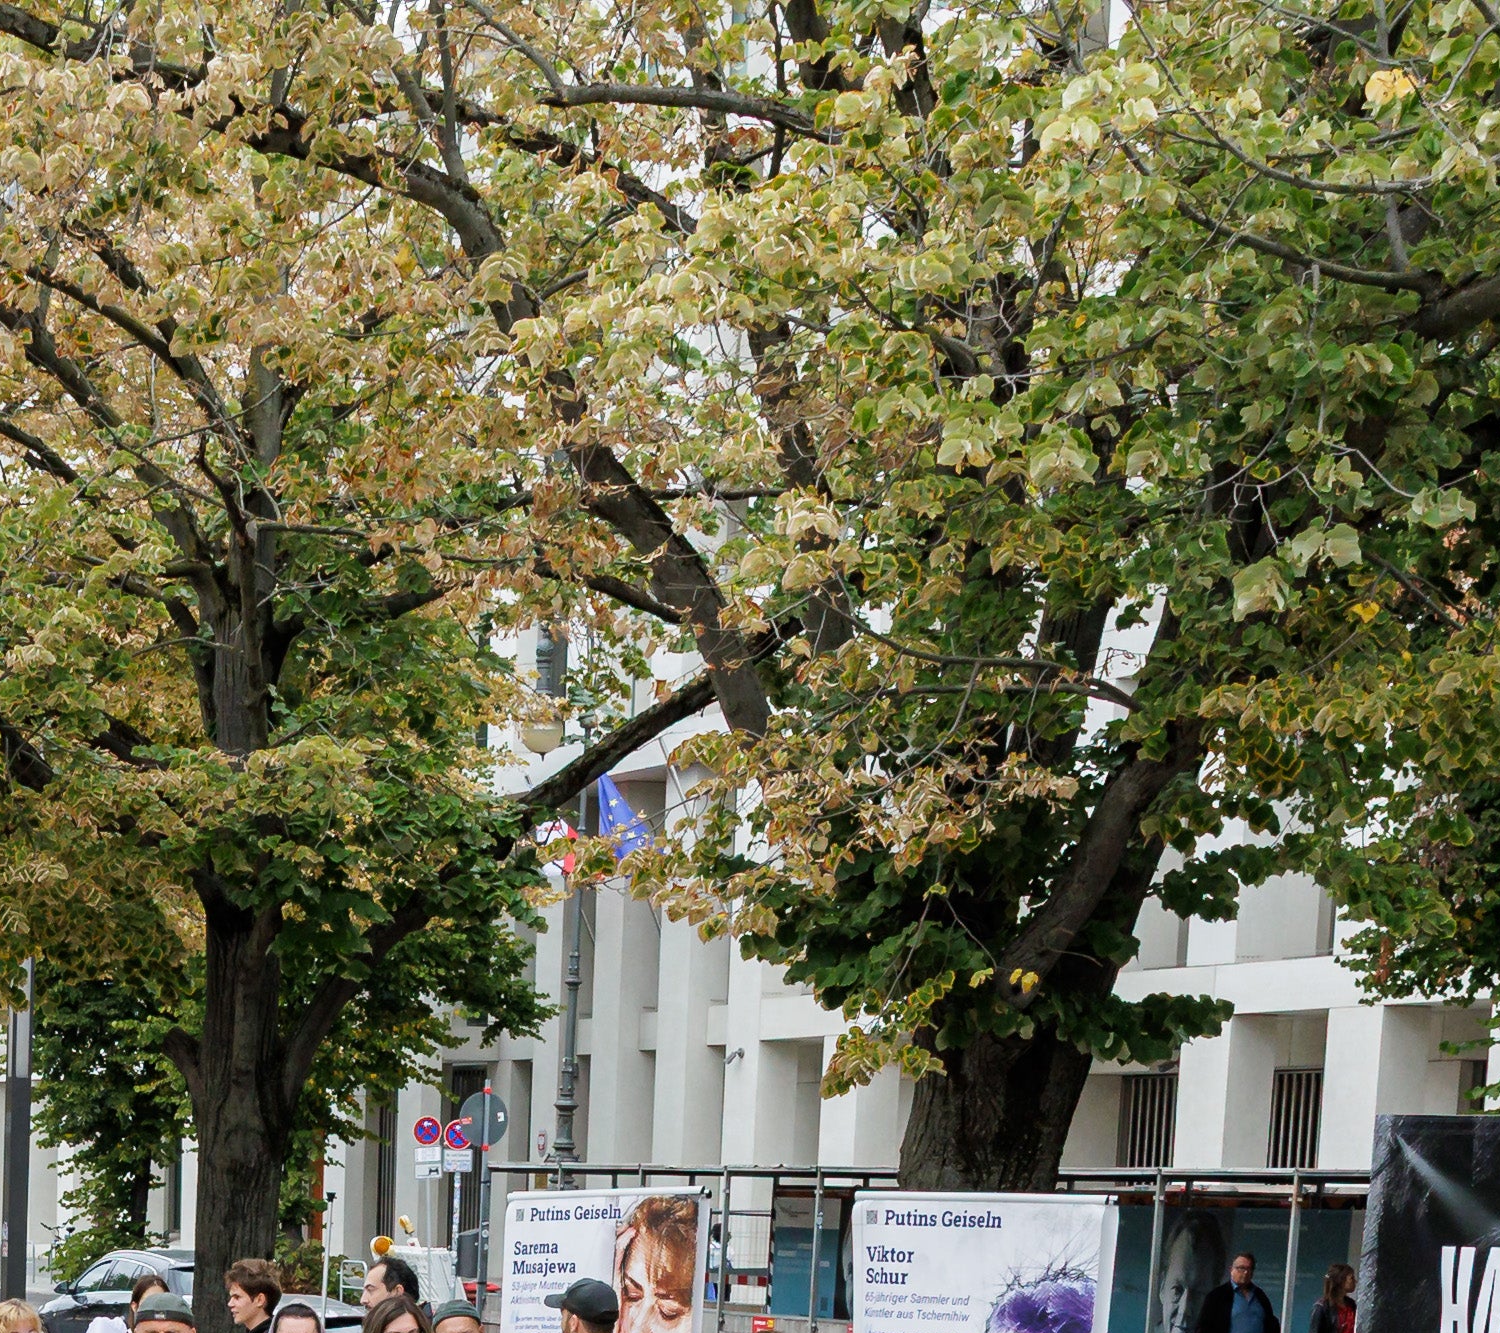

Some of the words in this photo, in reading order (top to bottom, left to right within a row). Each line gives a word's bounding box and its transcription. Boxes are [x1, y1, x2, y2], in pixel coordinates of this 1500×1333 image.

[530, 1205, 571, 1222] Putins
[574, 1204, 621, 1220] Geiseln
[884, 1209, 937, 1227] Putins
[941, 1210, 1002, 1229] Geiseln
[513, 1241, 558, 1255] Sarema
[866, 1245, 915, 1264] Viktor
[512, 1258, 576, 1277] Musajewa
[865, 1267, 908, 1285] Schur
[538, 1280, 565, 1290] Mutter
[910, 1293, 949, 1305] Sammler
[951, 1295, 970, 1306] und
[896, 1310, 913, 1319] aus
[916, 1309, 970, 1322] Tschernihiw
